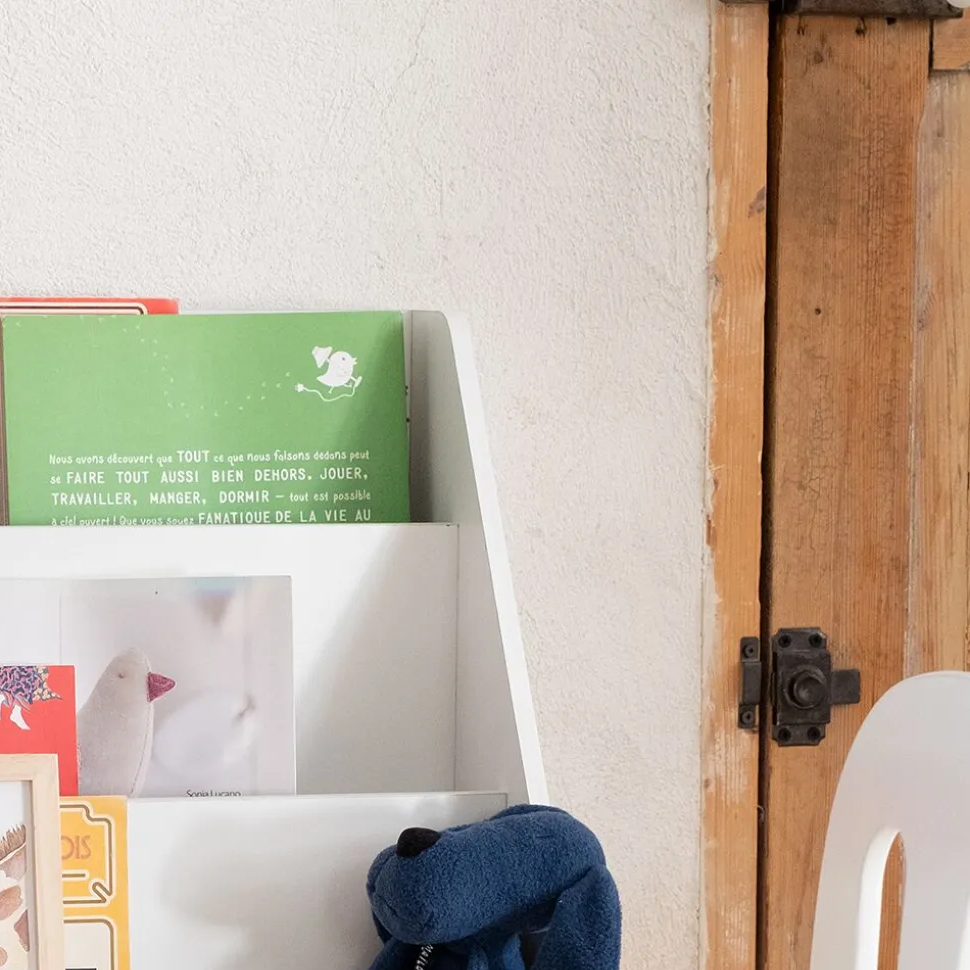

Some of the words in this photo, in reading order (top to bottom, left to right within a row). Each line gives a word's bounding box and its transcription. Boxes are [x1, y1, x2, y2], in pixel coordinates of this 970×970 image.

[49, 454, 73, 465] Nous
[75, 454, 104, 464] avons
[107, 453, 153, 464] découvert
[156, 455, 173, 467] que
[177, 450, 210, 463] TOUT
[213, 454, 224, 463] ce
[227, 453, 244, 466] que
[247, 452, 271, 462] nous
[274, 449, 310, 462] faisons
[313, 450, 347, 461] dedans
[349, 450, 370, 462] peut
[49, 474, 62, 484] se
[66, 471, 105, 484] FAIRE
[115, 471, 149, 484] TOUT
[160, 470, 199, 483] AUSSI
[211, 469, 244, 483] BIEN
[254, 468, 313, 482] DEHORS.
[319, 467, 369, 481] JOUER,
[51, 492, 138, 506] TRAVAILLER,
[149, 491, 207, 506] MANGER,
[219, 490, 270, 504] DORMIR
[289, 492, 309, 503] tout
[313, 491, 329, 501] est
[333, 489, 371, 503] possible
[198, 510, 271, 525] FANATIQUE
[275, 510, 292, 523] DE
[299, 510, 317, 523] LA
[324, 509, 347, 522] VIE
[355, 508, 371, 522] AU
